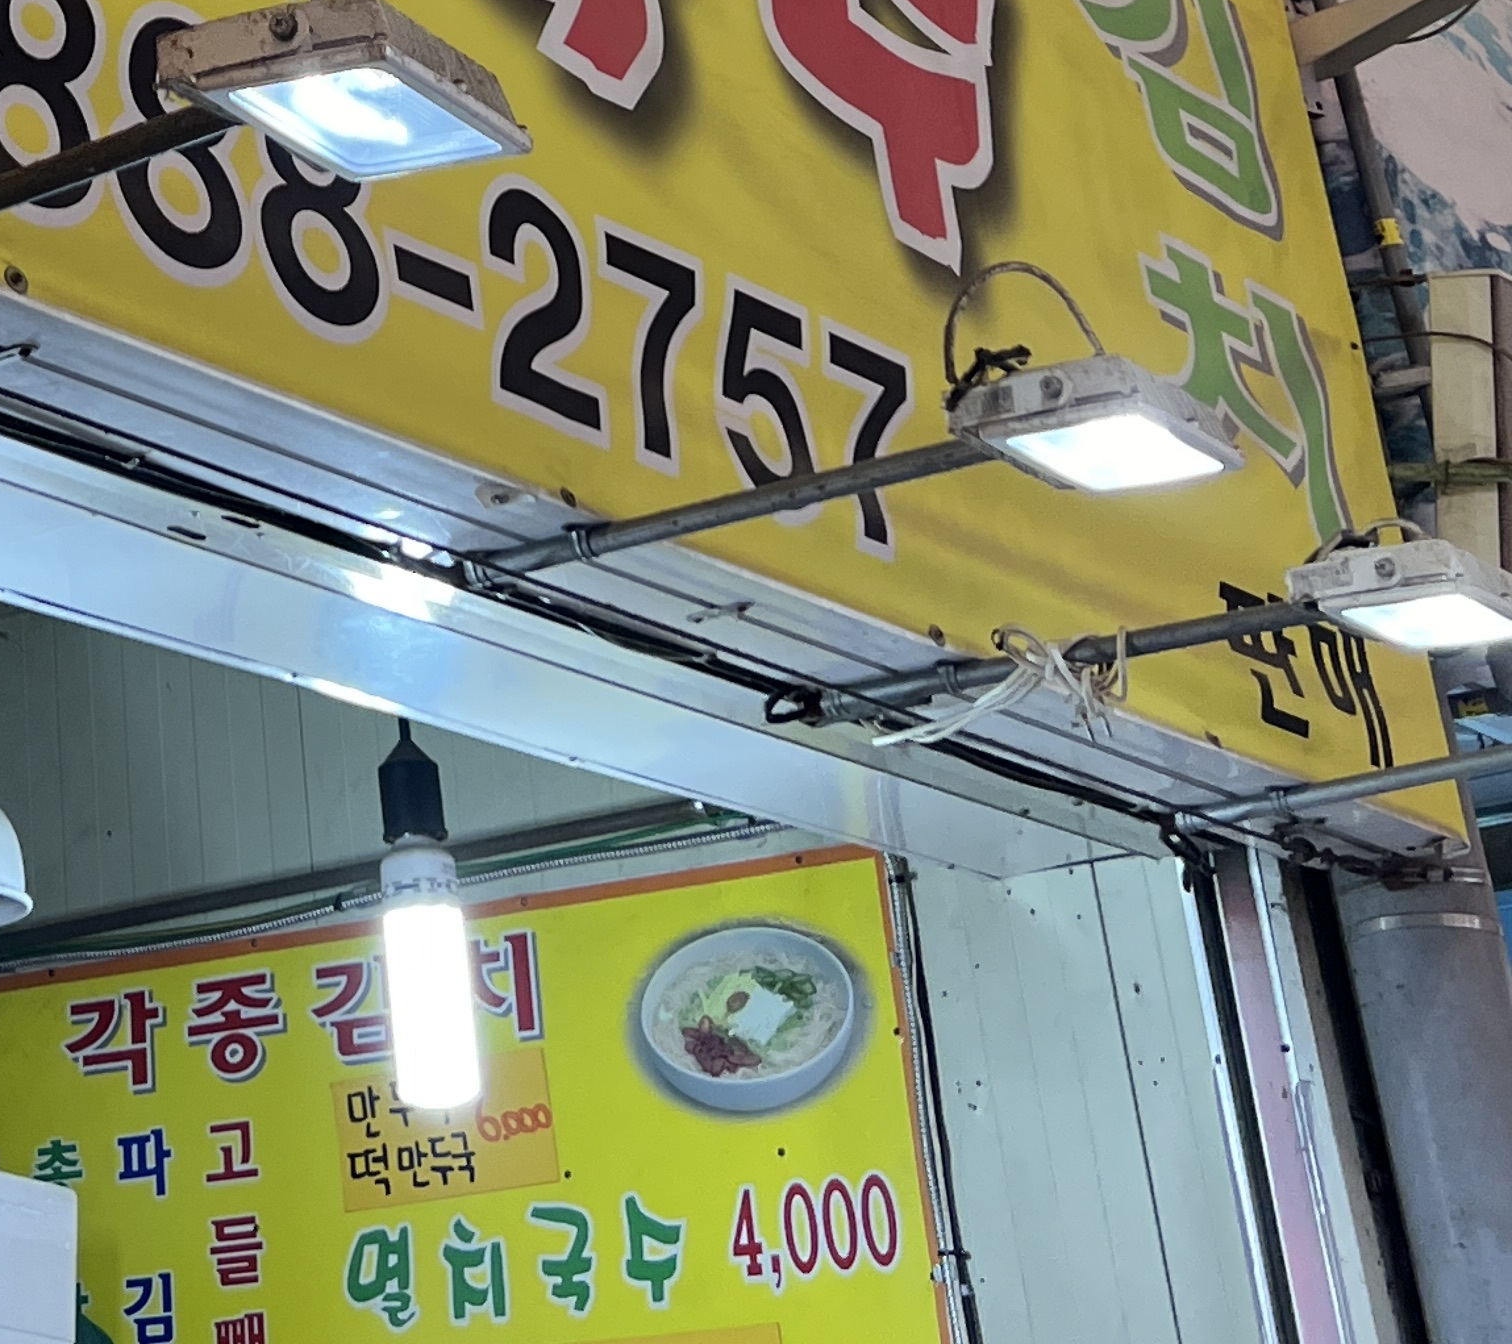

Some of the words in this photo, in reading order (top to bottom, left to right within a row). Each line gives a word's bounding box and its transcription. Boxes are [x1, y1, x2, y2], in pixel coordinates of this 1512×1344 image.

[1219, 581, 1394, 769] 판매
[347, 1131, 476, 1197] 떡만두국
[731, 1172, 899, 1290] 4,000
